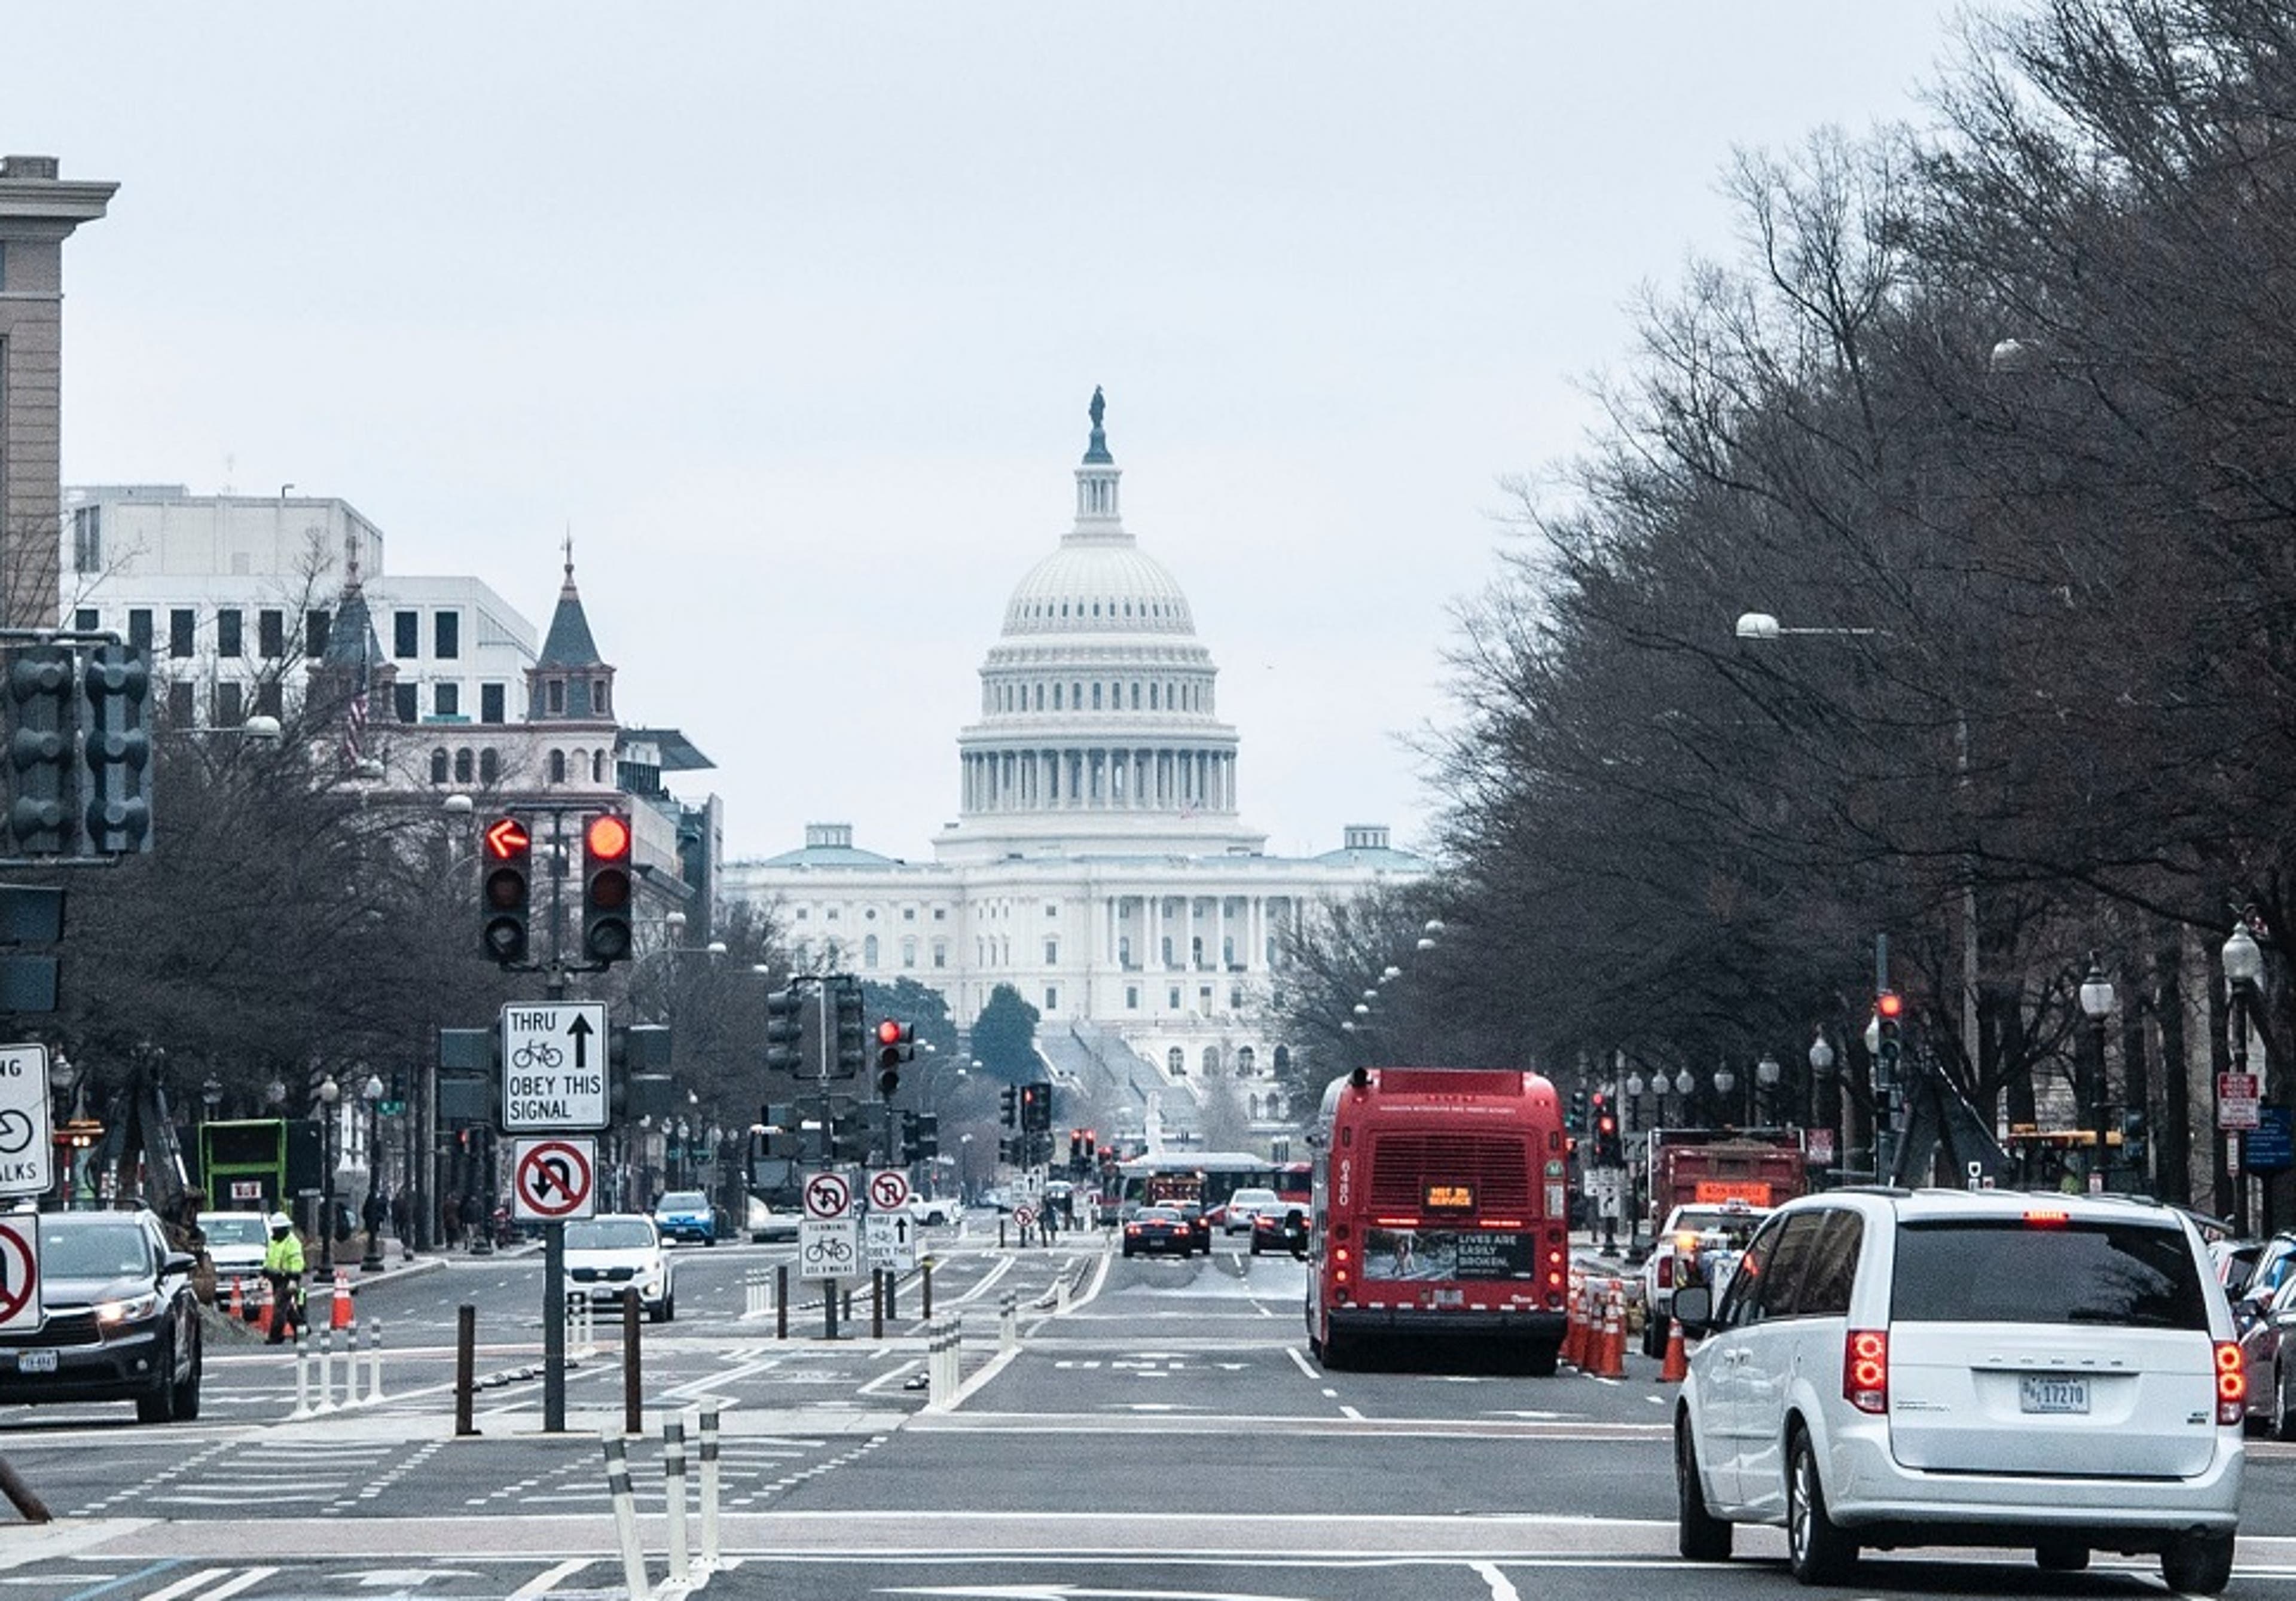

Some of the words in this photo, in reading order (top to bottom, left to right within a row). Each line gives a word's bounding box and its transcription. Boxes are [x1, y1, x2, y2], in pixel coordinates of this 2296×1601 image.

[510, 1012, 557, 1032] THRU
[509, 1076, 556, 1096] OBEY
[564, 1075, 601, 1095] THIS
[509, 1100, 572, 1120] SIGNAL
[0, 1162, 36, 1181] LKS
[1459, 1235, 1491, 1243] LIVES
[1494, 1235, 1516, 1245] ARE
[1459, 1245, 1497, 1255] EASILY
